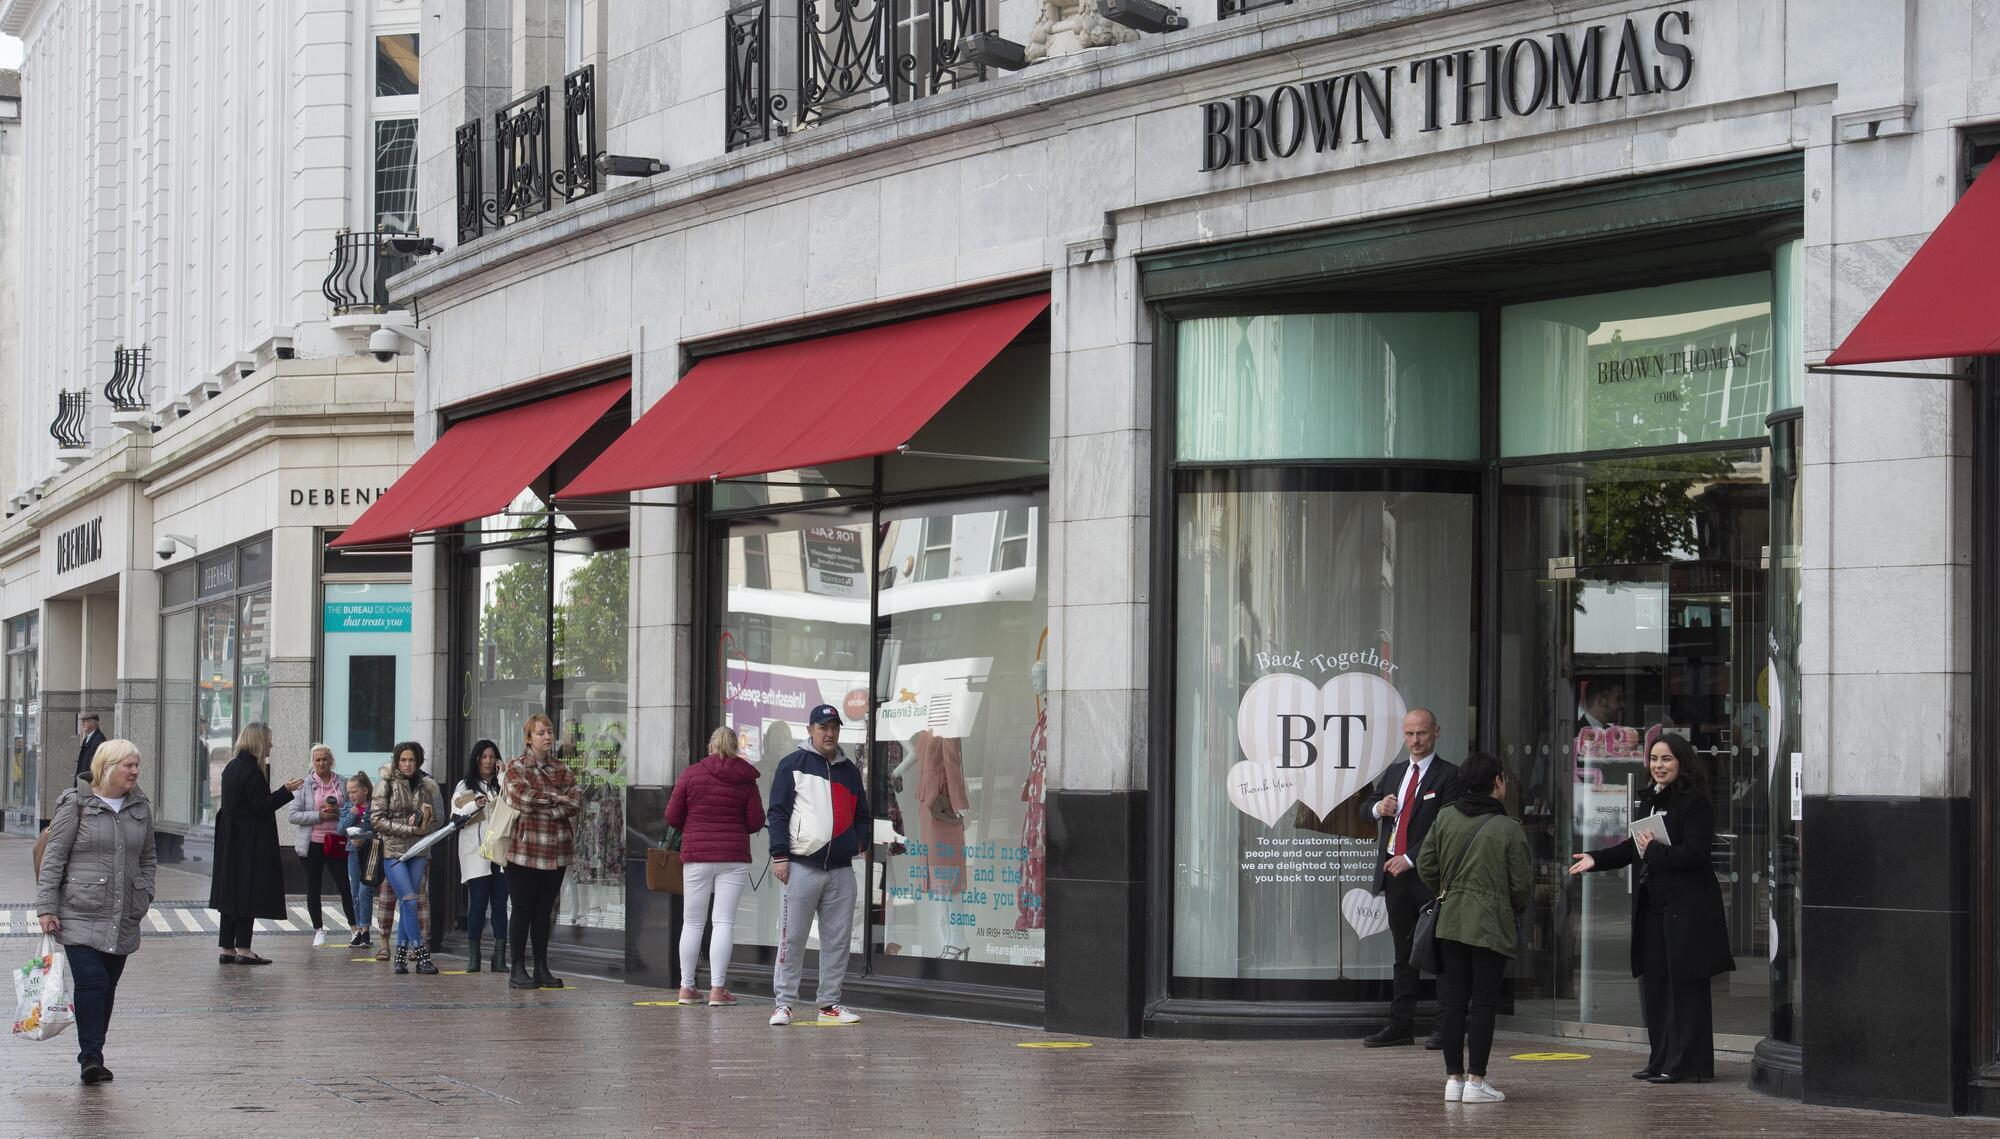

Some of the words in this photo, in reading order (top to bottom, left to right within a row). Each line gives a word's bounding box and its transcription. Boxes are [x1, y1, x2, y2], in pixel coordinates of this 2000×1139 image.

[1199, 65, 1397, 172] BROWN
[1410, 10, 1694, 132] THOMAS
[1597, 353, 1664, 384] BROWN
[1669, 343, 1748, 375] THOMAS
[1654, 389, 1680, 404] CORK
[57, 515, 103, 576] DEBENHAMS
[204, 560, 234, 590] DEBENHAMS
[328, 606, 342, 614] THE
[343, 606, 374, 614] BUREAU
[375, 606, 385, 614] DE
[343, 616, 361, 626] that
[361, 616, 385, 626] treats
[385, 618, 403, 630] you
[1255, 650, 1305, 671] Back
[1310, 648, 1399, 675] Together
[1276, 714, 1367, 769] BT
[1238, 779, 1270, 796] Thank
[1272, 778, 1296, 791] You
[1257, 837, 1270, 846] To
[1272, 838, 1290, 846] our
[1292, 837, 1353, 847] customers,
[1355, 838, 1374, 846] our
[1001, 847, 1029, 861] nice
[1245, 849, 1280, 860] people
[1282, 849, 1303, 858] and
[1305, 850, 1323, 858] our
[1241, 862, 1256, 870] we
[1257, 862, 1274, 870] are
[1276, 861, 1327, 872] delighted
[1329, 862, 1341, 870] to
[1343, 861, 1377, 870] welco
[909, 865, 928, 878] and
[974, 865, 994, 882] and
[1001, 866, 1022, 884] the
[1255, 874, 1274, 884] you
[1275, 873, 1302, 882] back
[1303, 874, 1315, 882] to
[1318, 874, 1337, 882] our
[1338, 874, 1374, 882] stores
[890, 883, 922, 900] world
[927, 885, 953, 902] will
[961, 887, 987, 904] take
[993, 892, 1014, 910] you
[950, 912, 976, 926] same
[977, 928, 985, 937] AN
[986, 927, 1001, 938] IRISH
[1002, 928, 1030, 940] PROVERB
